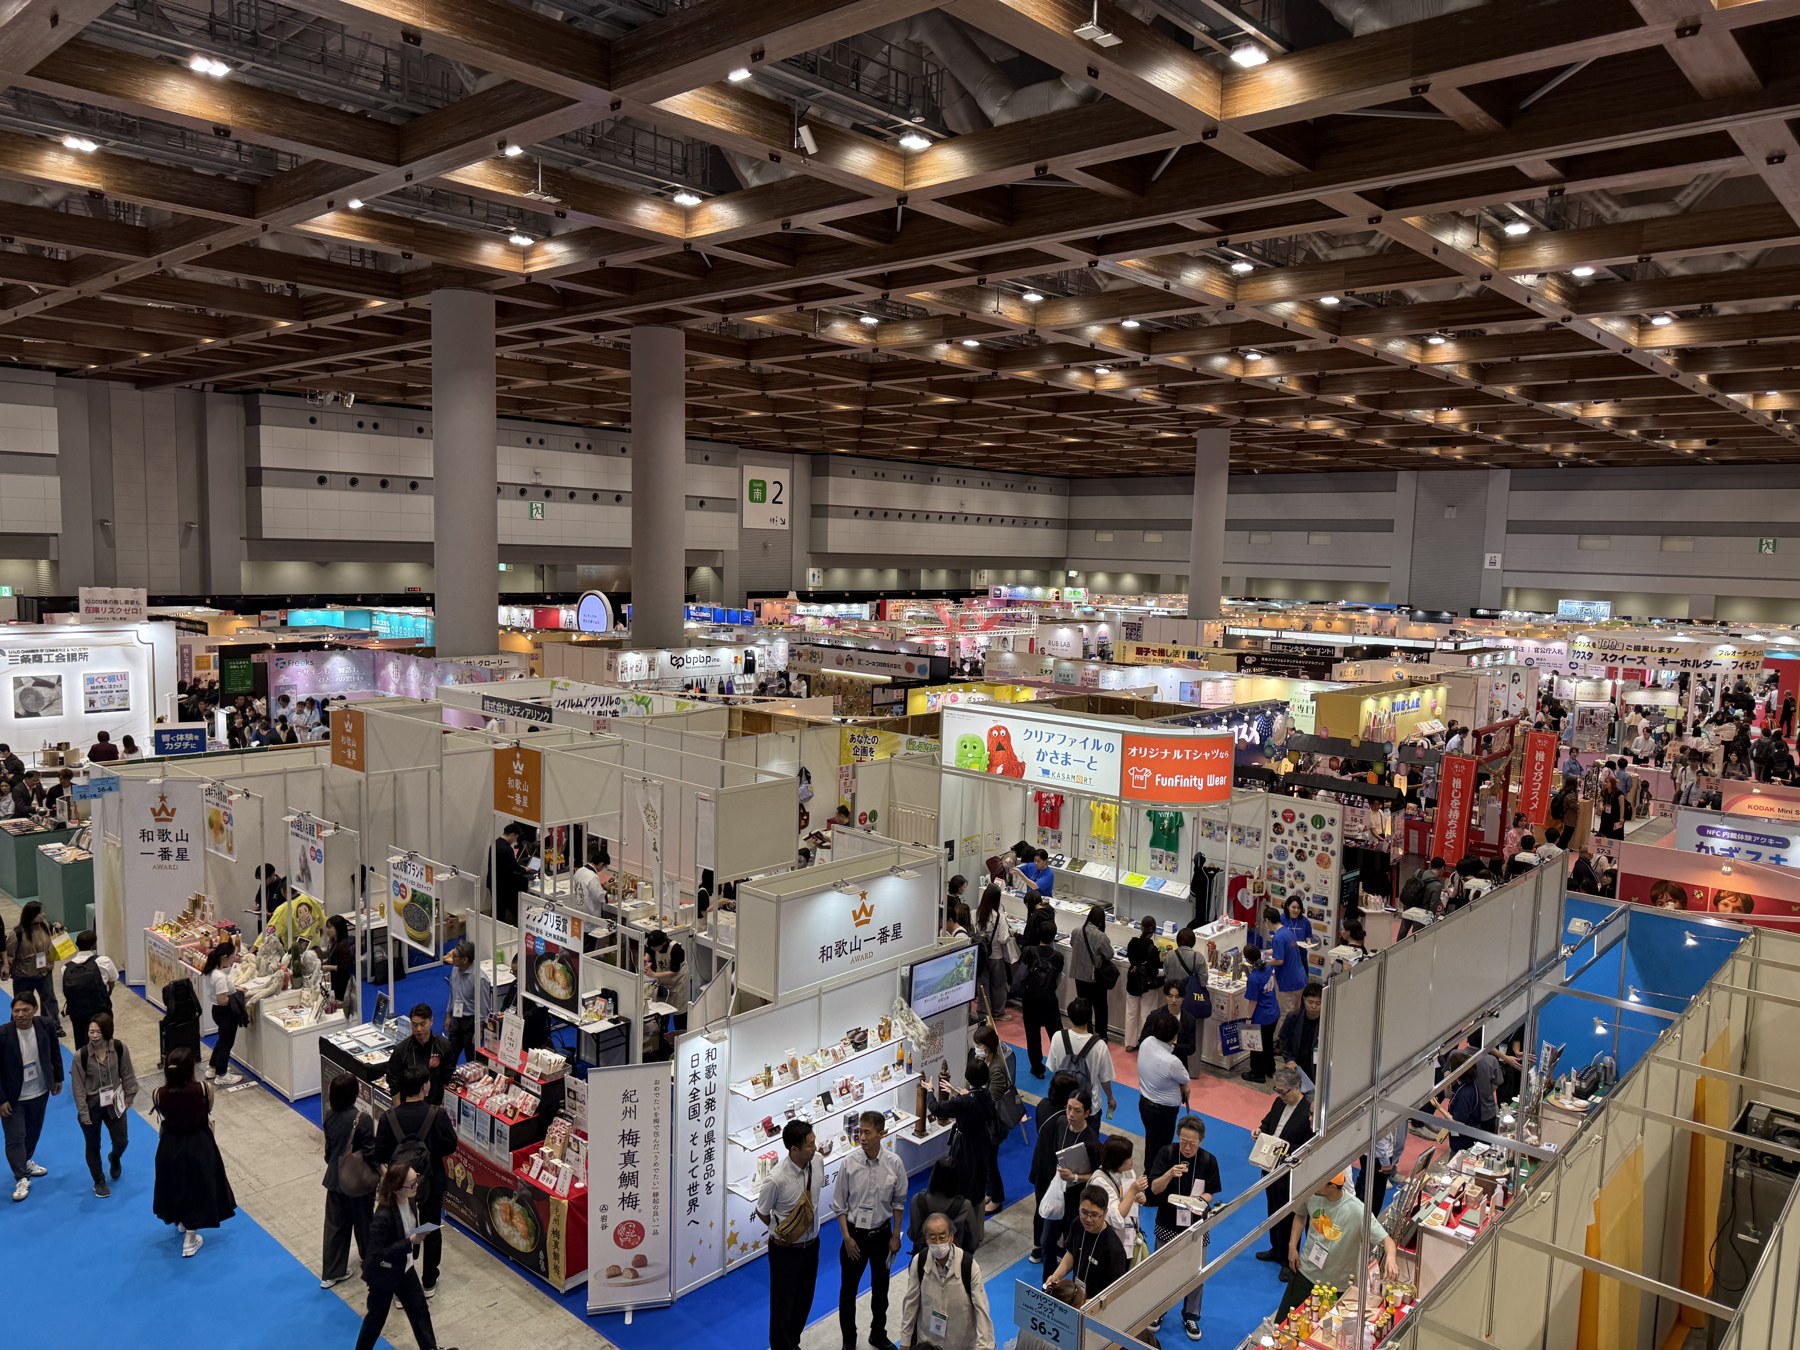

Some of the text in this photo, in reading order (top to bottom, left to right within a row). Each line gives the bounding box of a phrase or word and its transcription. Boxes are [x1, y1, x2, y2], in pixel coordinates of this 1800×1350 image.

[754, 488, 762, 500] 南
[772, 480, 783, 504] 2
[8, 652, 89, 665] 三条商工会議所
[686, 654, 711, 664] bpbp
[1572, 650, 1760, 672] アクスタ スクイーズ キーホルダー フィギュア
[484, 700, 549, 722] 株式会社メディアリンク
[164, 742, 197, 750] カタチに
[849, 734, 878, 745] あなたの
[1023, 728, 1115, 754] クリアファイルの
[852, 746, 875, 756] 企画を
[1128, 746, 1229, 760] オリジナルTシャツなら
[1036, 748, 1098, 771] かさまーと
[507, 777, 528, 792] 和歌山
[1155, 774, 1227, 790] FunFinity Wear
[1529, 751, 1546, 810] 推し乃コスメ
[508, 794, 528, 807] 一番星
[1445, 777, 1462, 849] 推しを持ち歩く
[1747, 804, 1775, 813] KODAK
[1777, 806, 1793, 815] Mini
[139, 828, 189, 843] 和歌山
[1706, 829, 1721, 837] NFC
[140, 847, 190, 862] 一番星
[818, 922, 903, 964] 和歌山一番星
[850, 951, 874, 964] AWARD
[702, 1047, 717, 1195] 和歌山発の県産品を
[686, 1053, 701, 1227] 日本全国、そして世界へ
[617, 1088, 641, 1212] 紀州 梅真鯛梅
[1037, 1302, 1054, 1316] グッズ
[1030, 1317, 1060, 1343] S6-2
